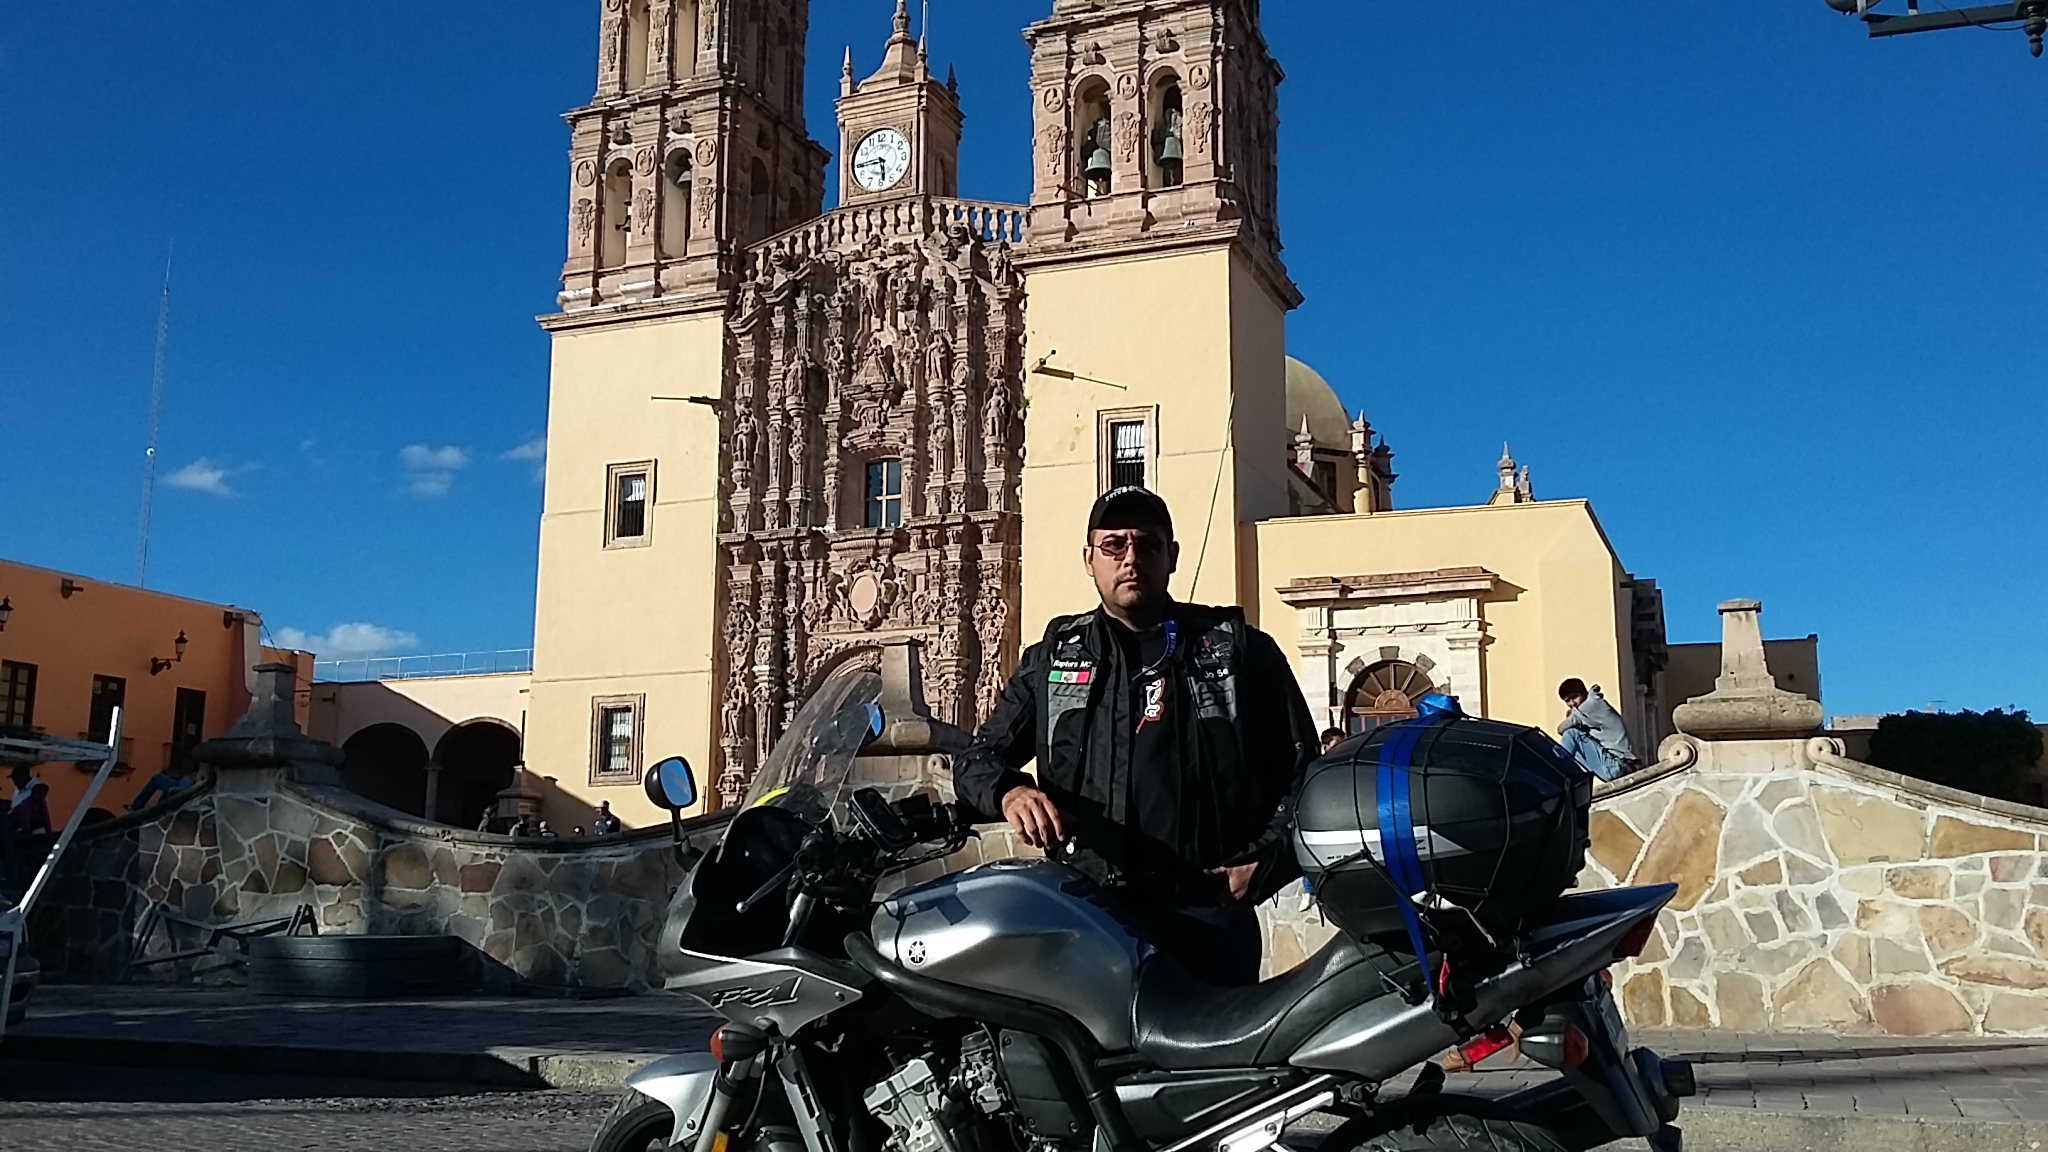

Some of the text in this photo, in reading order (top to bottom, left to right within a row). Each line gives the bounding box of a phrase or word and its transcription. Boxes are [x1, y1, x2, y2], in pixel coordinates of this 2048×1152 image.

[869, 138, 874, 147] 11
[877, 133, 886, 143] 12
[890, 134, 894, 143] 1
[897, 141, 903, 150] 2
[860, 147, 868, 156] 10
[901, 152, 906, 161] 3
[896, 164, 902, 173] 4
[860, 170, 865, 179] 8
[889, 174, 894, 183] 5
[868, 177, 873, 187] 7
[878, 178, 884, 187] 6
[1053, 660, 1093, 669] Raptors MC
